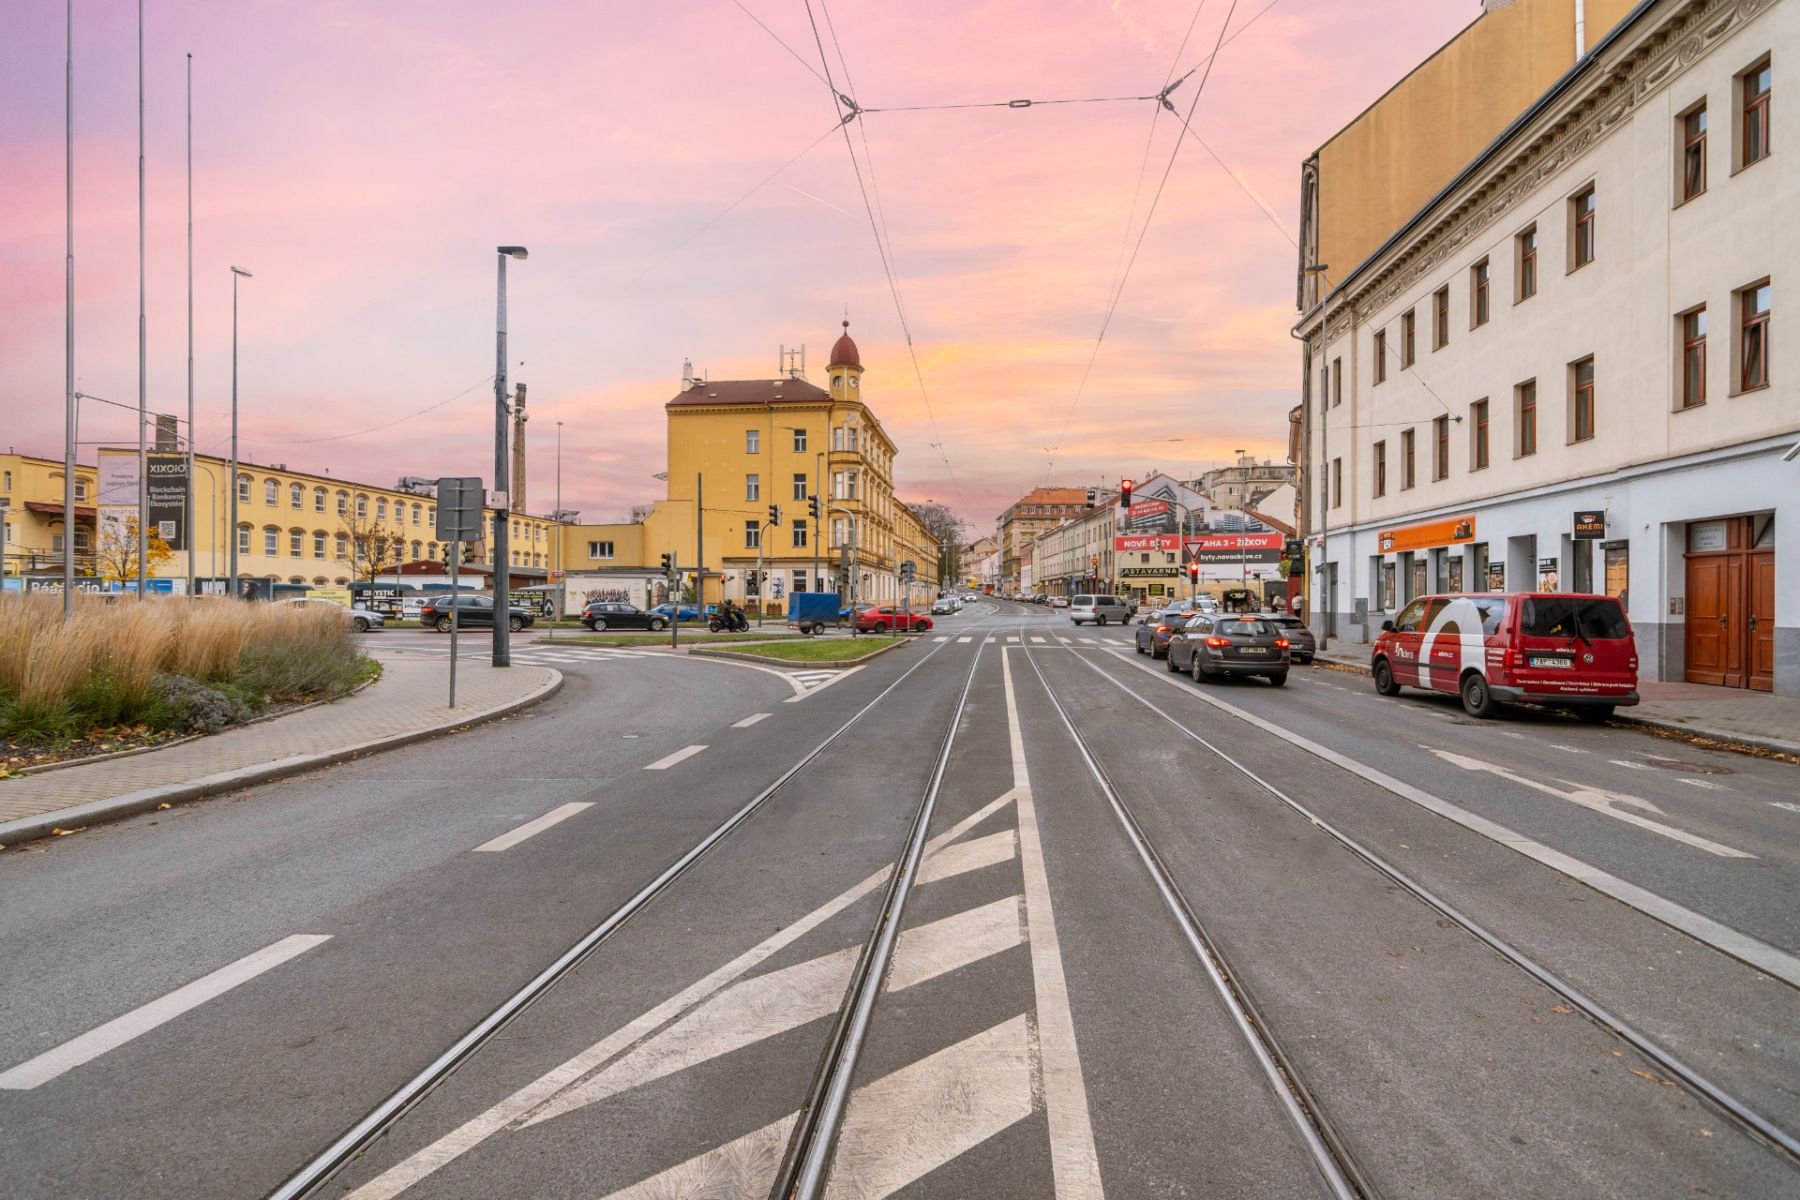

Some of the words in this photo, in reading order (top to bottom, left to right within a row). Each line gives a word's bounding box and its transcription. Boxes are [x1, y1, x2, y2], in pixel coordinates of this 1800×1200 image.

[1124, 539, 1147, 548] NOVÉ
[1149, 539, 1171, 547] BTY
[1223, 539, 1229, 547] 3
